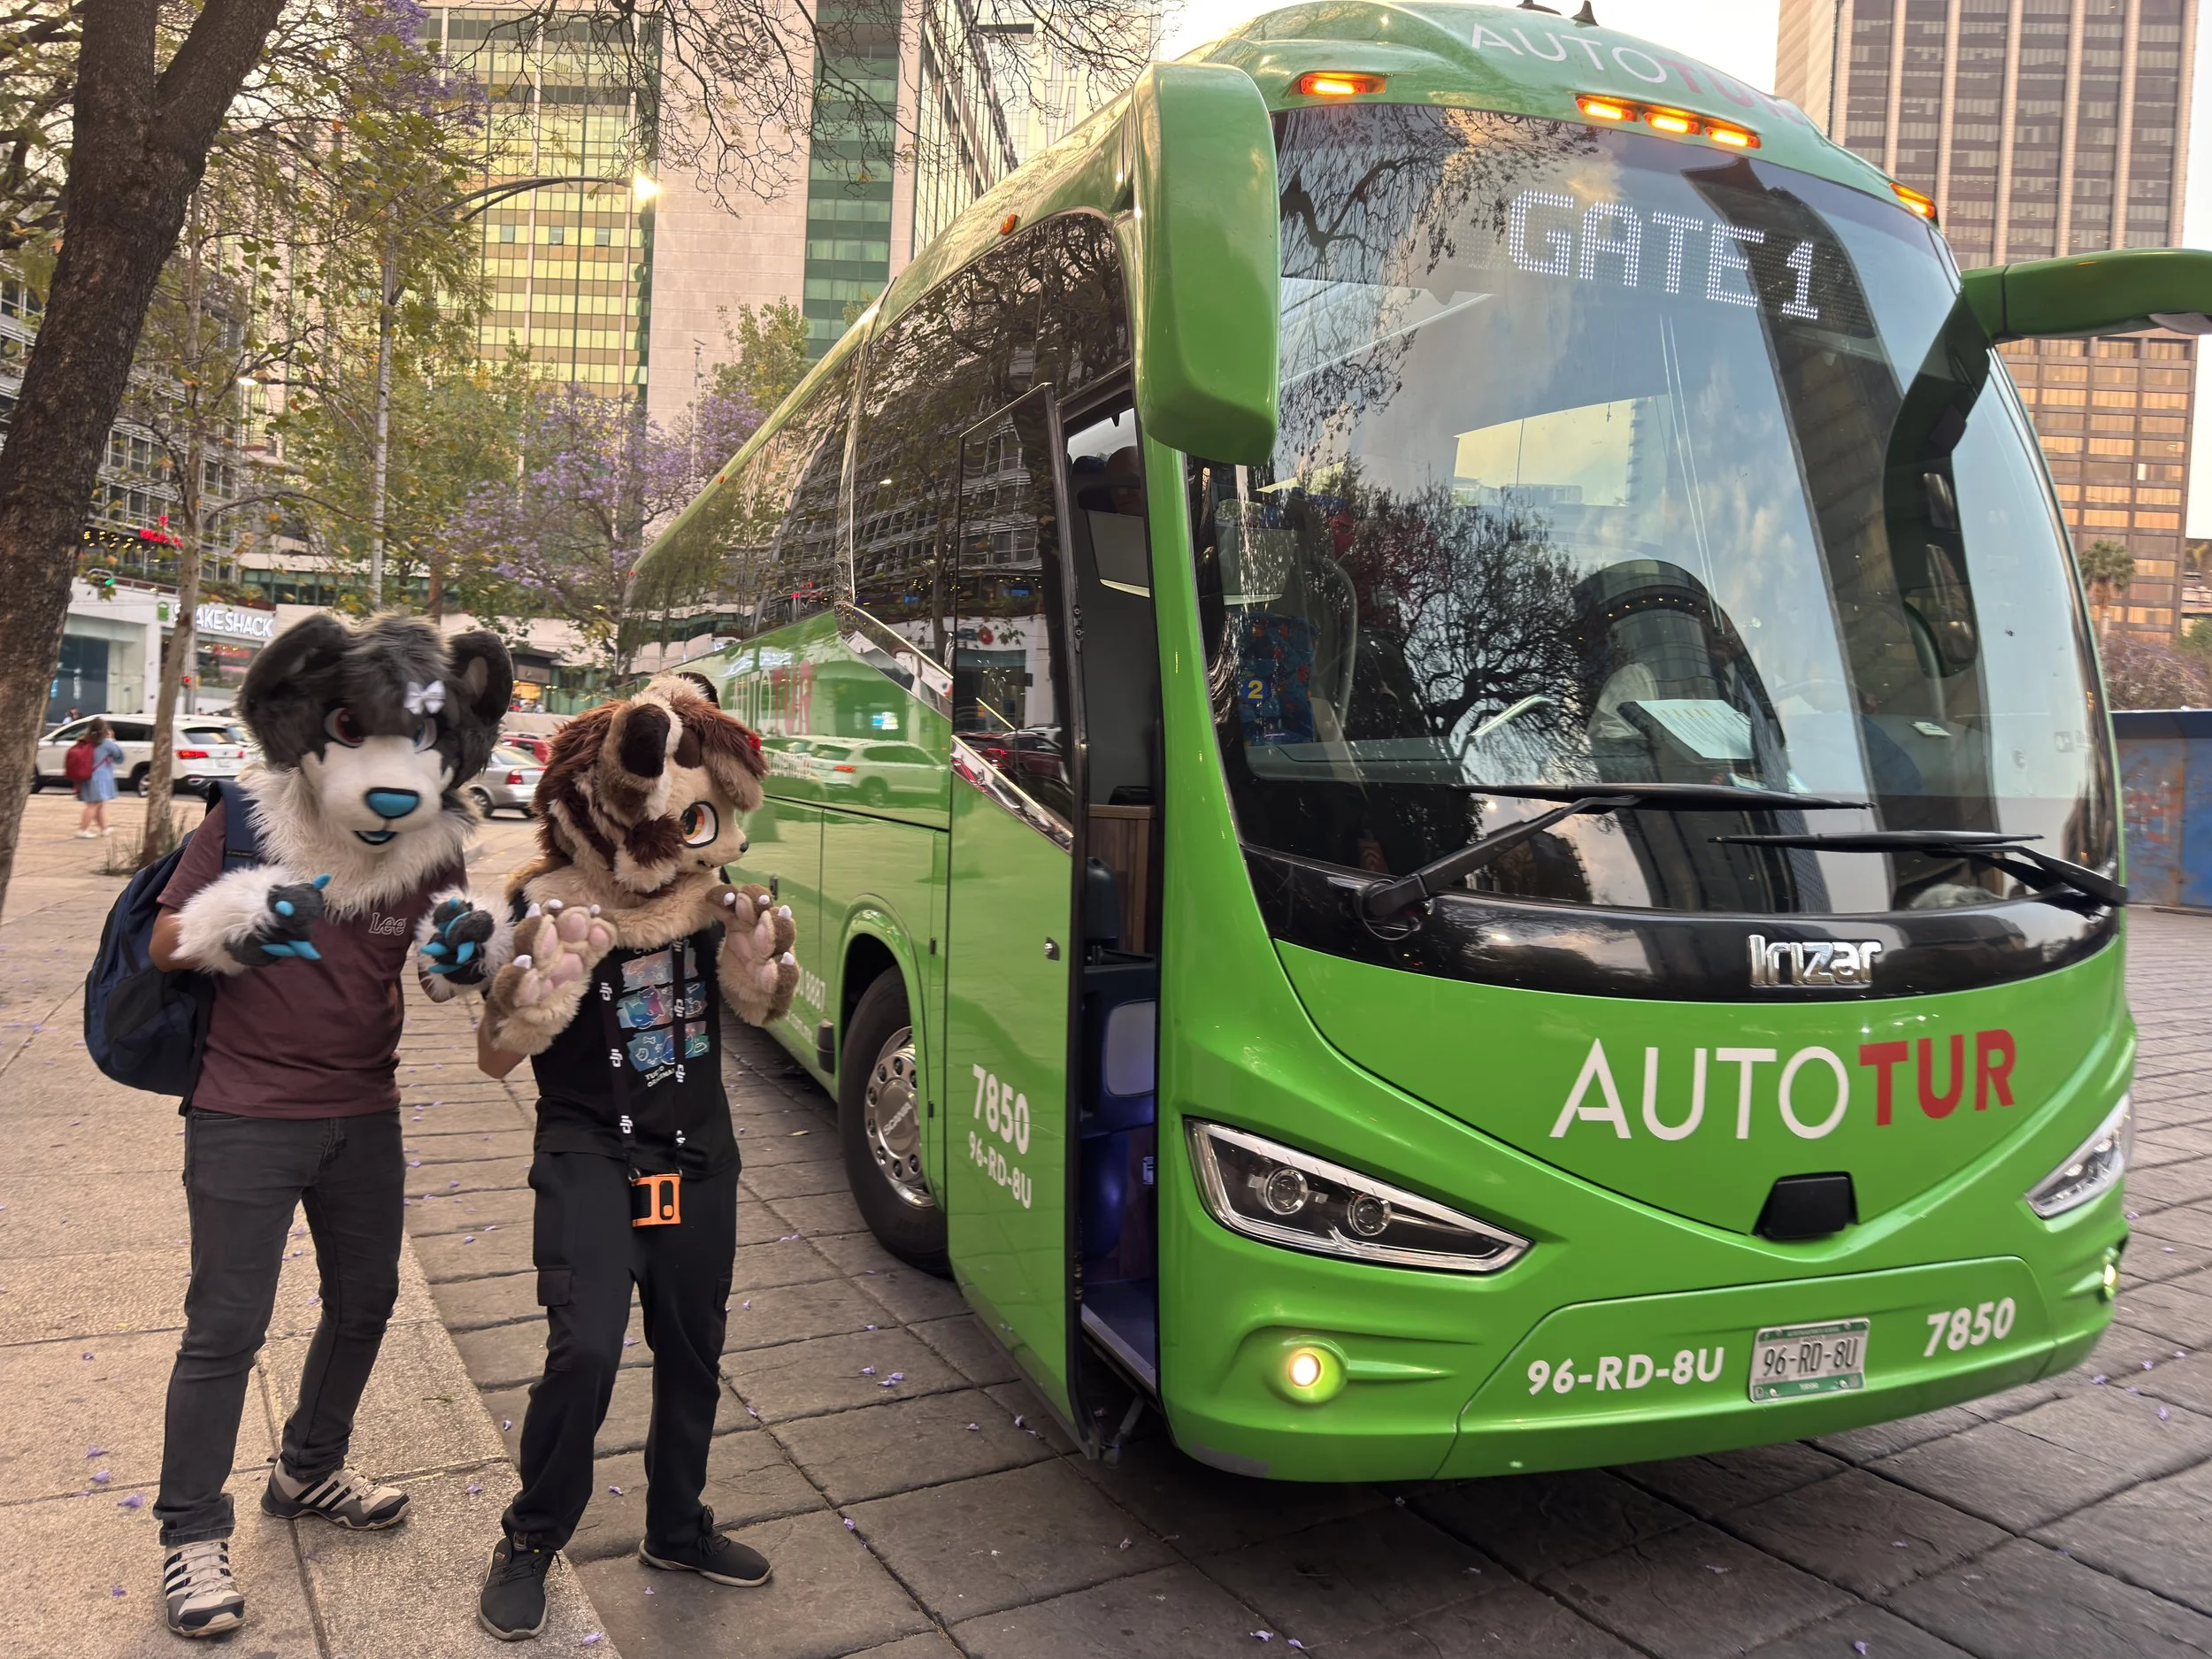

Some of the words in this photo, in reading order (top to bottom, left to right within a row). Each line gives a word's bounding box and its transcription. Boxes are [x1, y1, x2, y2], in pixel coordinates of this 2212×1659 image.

[1471, 22, 1806, 126] AUTOTUR
[1509, 188, 1764, 307] GATE
[1781, 241, 1819, 321] 1
[173, 603, 225, 630] SAKE
[225, 611, 273, 638] SHACK
[1248, 680, 1263, 699] 2
[369, 912, 407, 936] Lee
[1748, 934, 1882, 987] Irizar
[973, 1063, 1030, 1155] 7850
[1549, 1028, 2016, 1141] AUTOTUR
[969, 1130, 1032, 1210] 96-RD-8U
[1924, 1296, 2016, 1358] 7850
[1527, 1346, 1724, 1395] 96-RD-8U
[1763, 1337, 1859, 1377] 96-RD-8U
